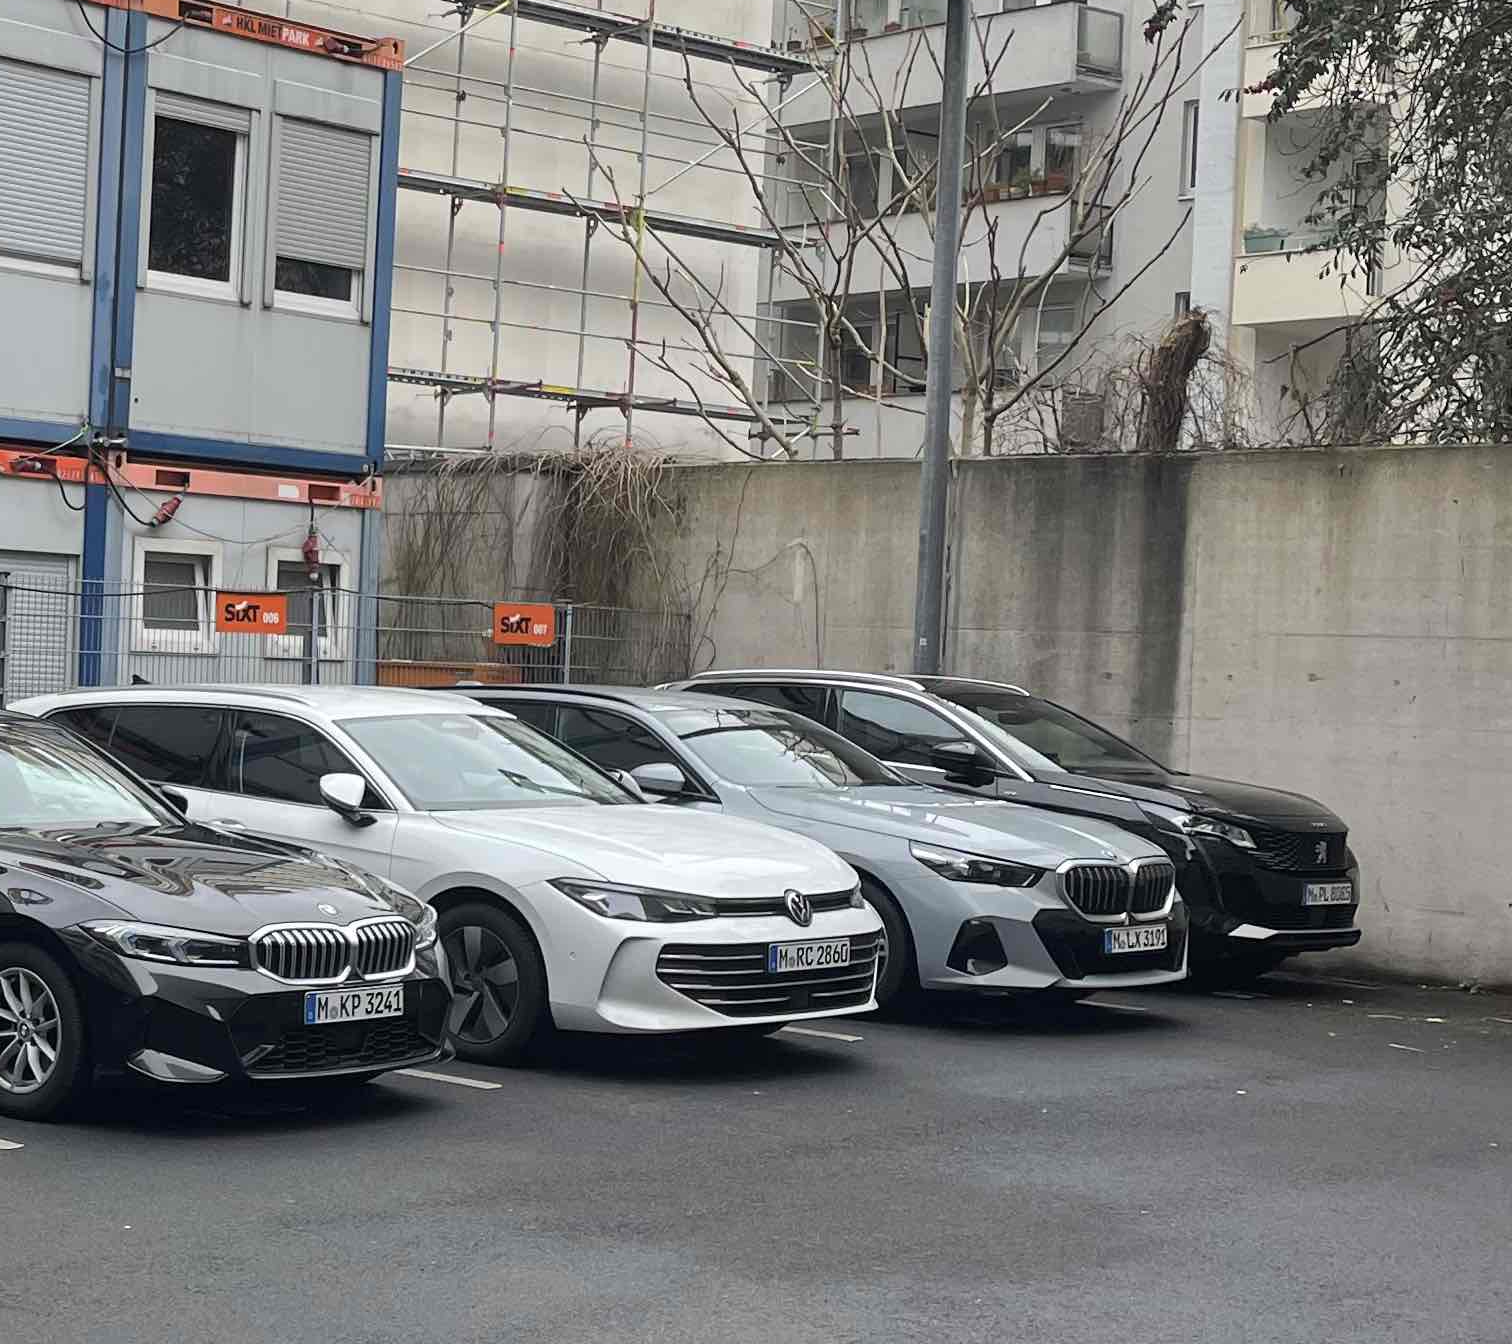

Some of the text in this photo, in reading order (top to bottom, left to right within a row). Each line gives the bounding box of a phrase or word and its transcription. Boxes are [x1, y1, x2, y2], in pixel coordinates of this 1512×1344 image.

[224, 601, 280, 624] SIXT 006
[779, 943, 848, 969] M RC 2860
[317, 997, 329, 1020] M
[340, 993, 361, 1017] KP
[365, 990, 402, 1015] 3241
